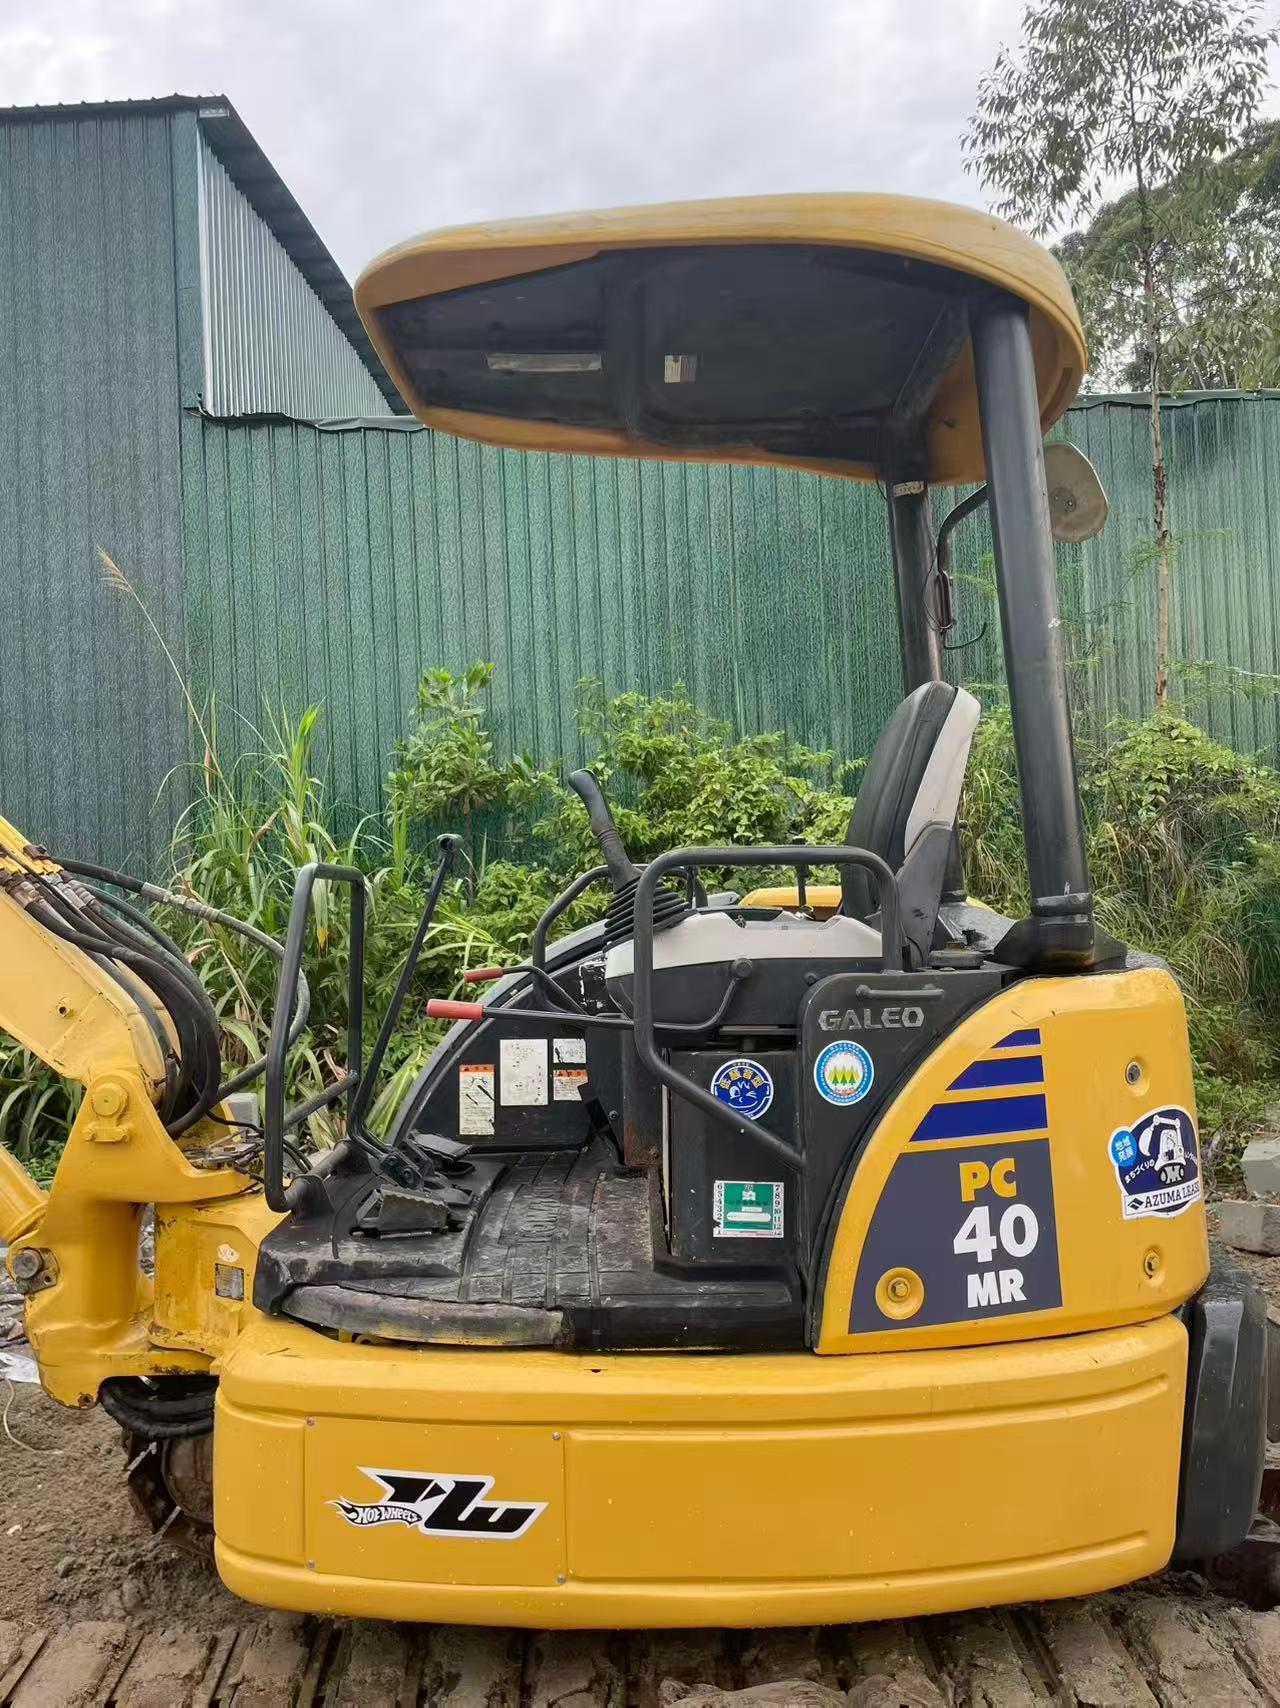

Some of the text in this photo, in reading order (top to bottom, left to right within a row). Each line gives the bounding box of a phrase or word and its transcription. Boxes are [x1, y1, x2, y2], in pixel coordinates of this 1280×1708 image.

[818, 1007, 925, 1031] GALEO
[959, 1157, 1017, 1202] PC
[1144, 1189, 1182, 1208] AZUMA
[953, 1203, 1039, 1264] 40
[967, 1268, 1028, 1309] MR
[357, 1507, 381, 1524] HOT
